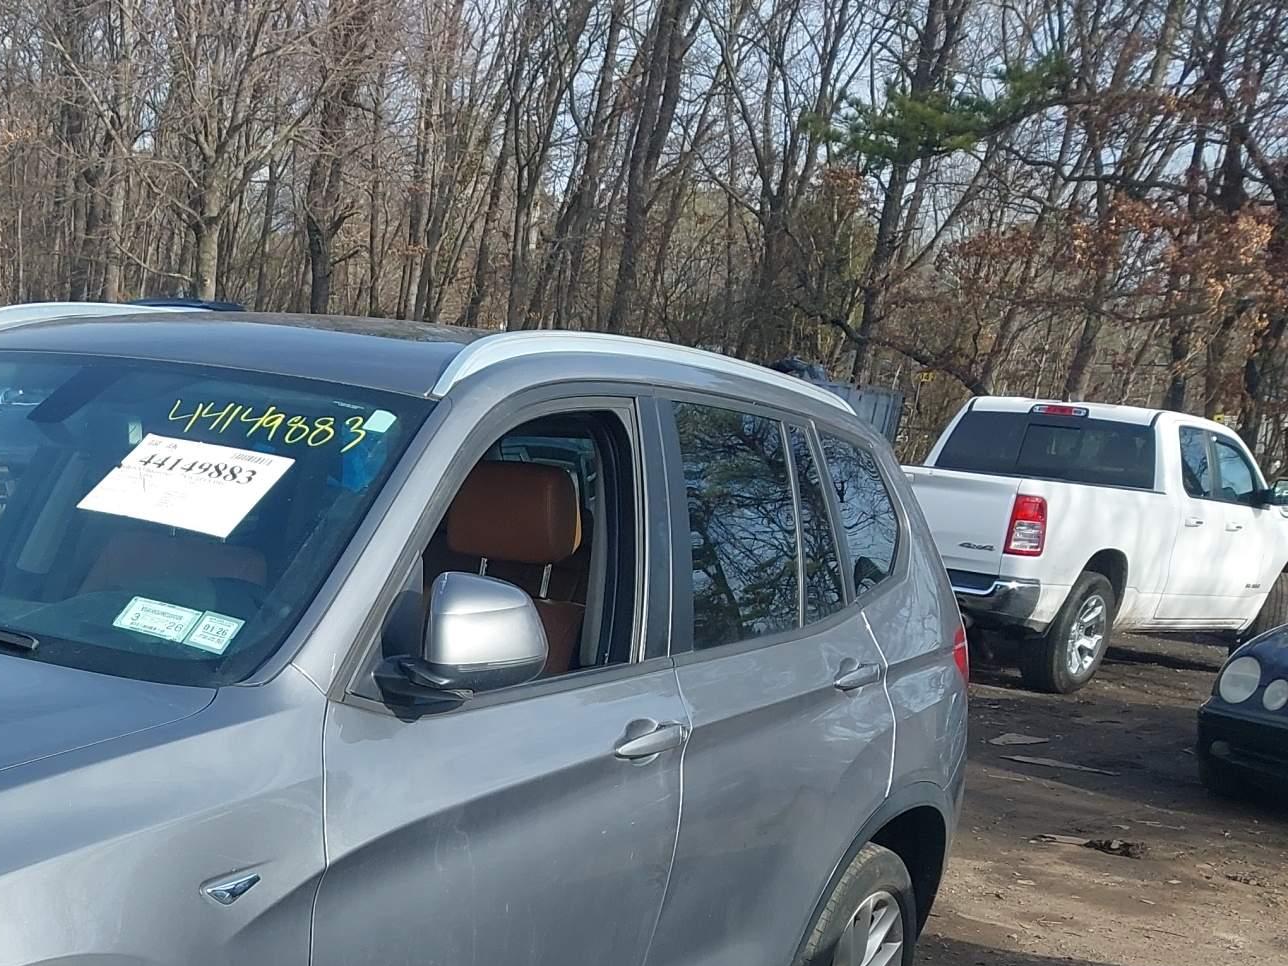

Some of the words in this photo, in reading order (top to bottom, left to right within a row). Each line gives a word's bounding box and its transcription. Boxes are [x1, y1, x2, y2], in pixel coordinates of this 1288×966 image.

[168, 399, 366, 453] 44149883
[139, 453, 257, 485] 44149883
[166, 621, 184, 633] 26
